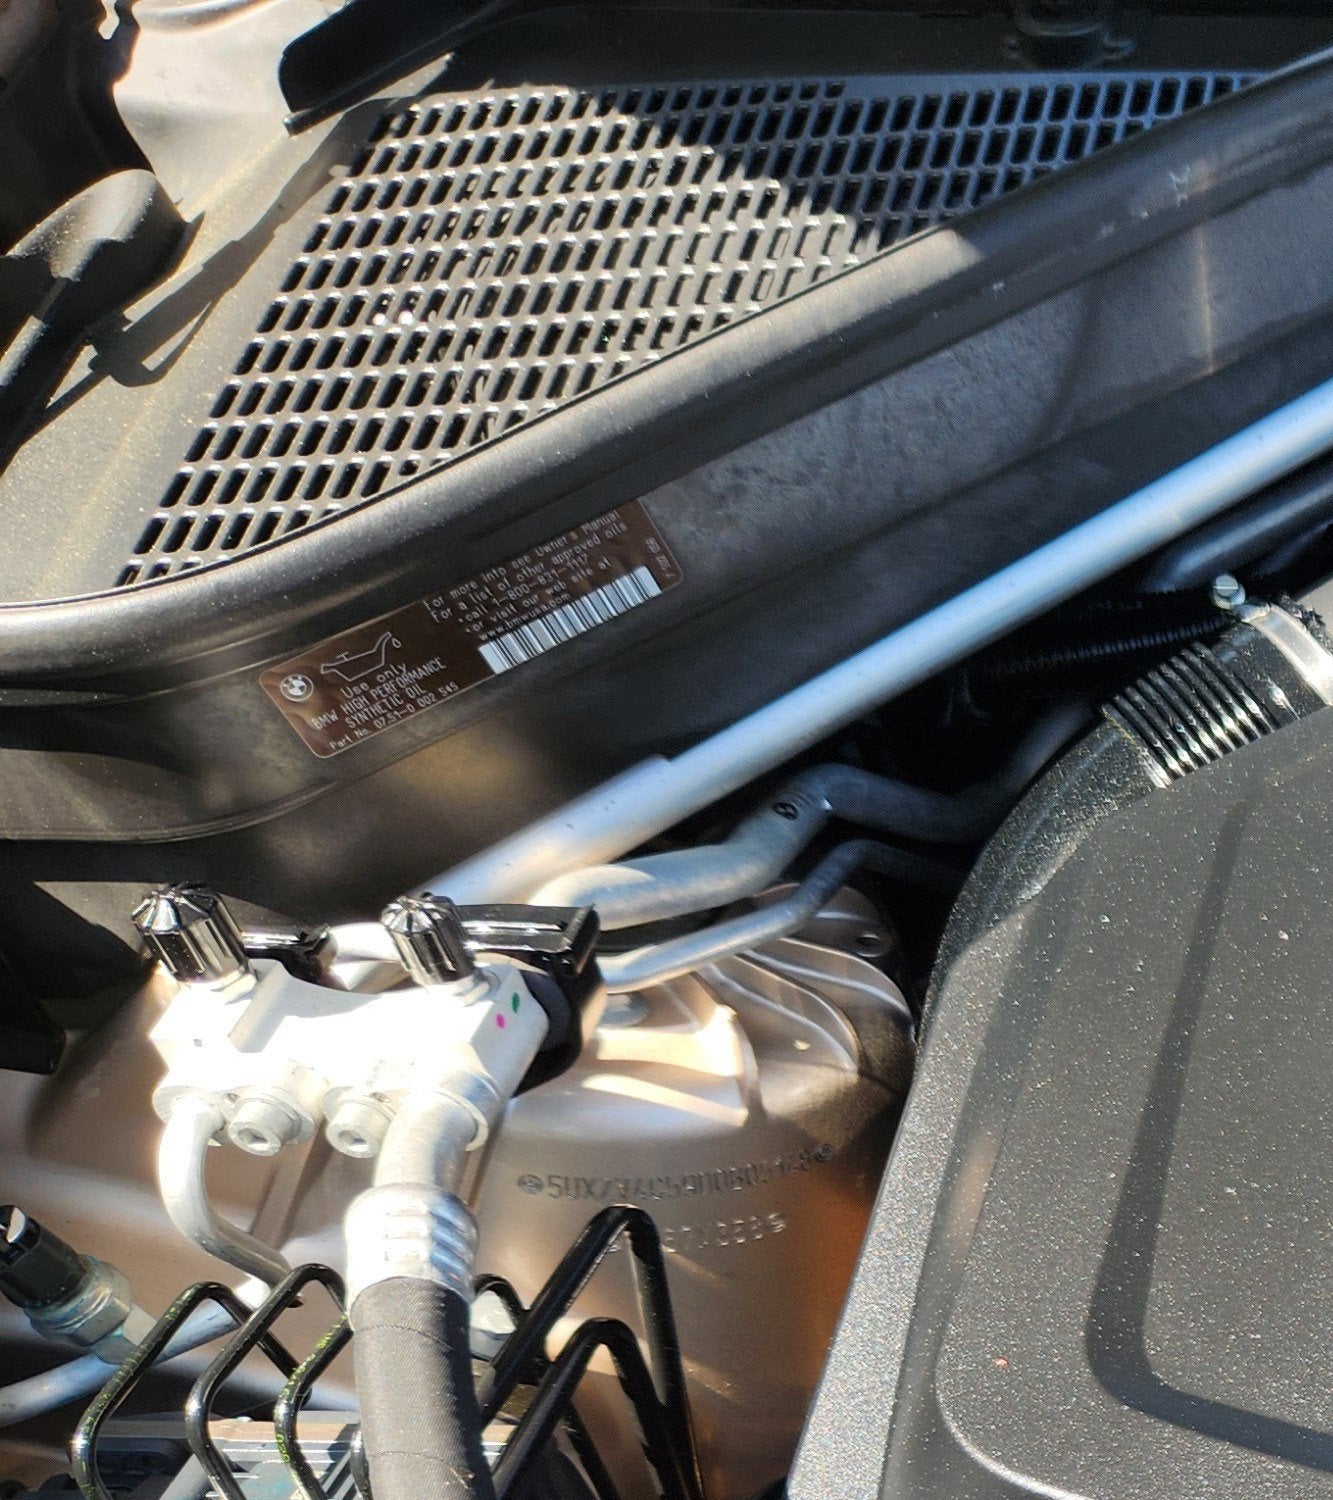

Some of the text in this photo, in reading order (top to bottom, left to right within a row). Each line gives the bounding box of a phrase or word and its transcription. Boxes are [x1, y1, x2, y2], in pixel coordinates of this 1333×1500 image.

[431, 522, 628, 623] For a list of other approved oils
[449, 581, 478, 600] more
[482, 566, 507, 582] info
[511, 554, 531, 568] see
[581, 510, 621, 532] Manual
[478, 592, 571, 641] www.bmwusa.com
[491, 604, 517, 623] visit
[522, 594, 540, 606] our
[545, 581, 567, 596] web
[571, 567, 594, 582] site
[598, 557, 611, 570] at
[311, 657, 446, 729] BMW HIGH PERFORMANCE
[341, 663, 408, 698] Use only
[344, 683, 426, 728] SYNTHETIC OIL
[329, 736, 352, 750] Part
[355, 728, 372, 737] No.
[418, 695, 437, 707] 002
